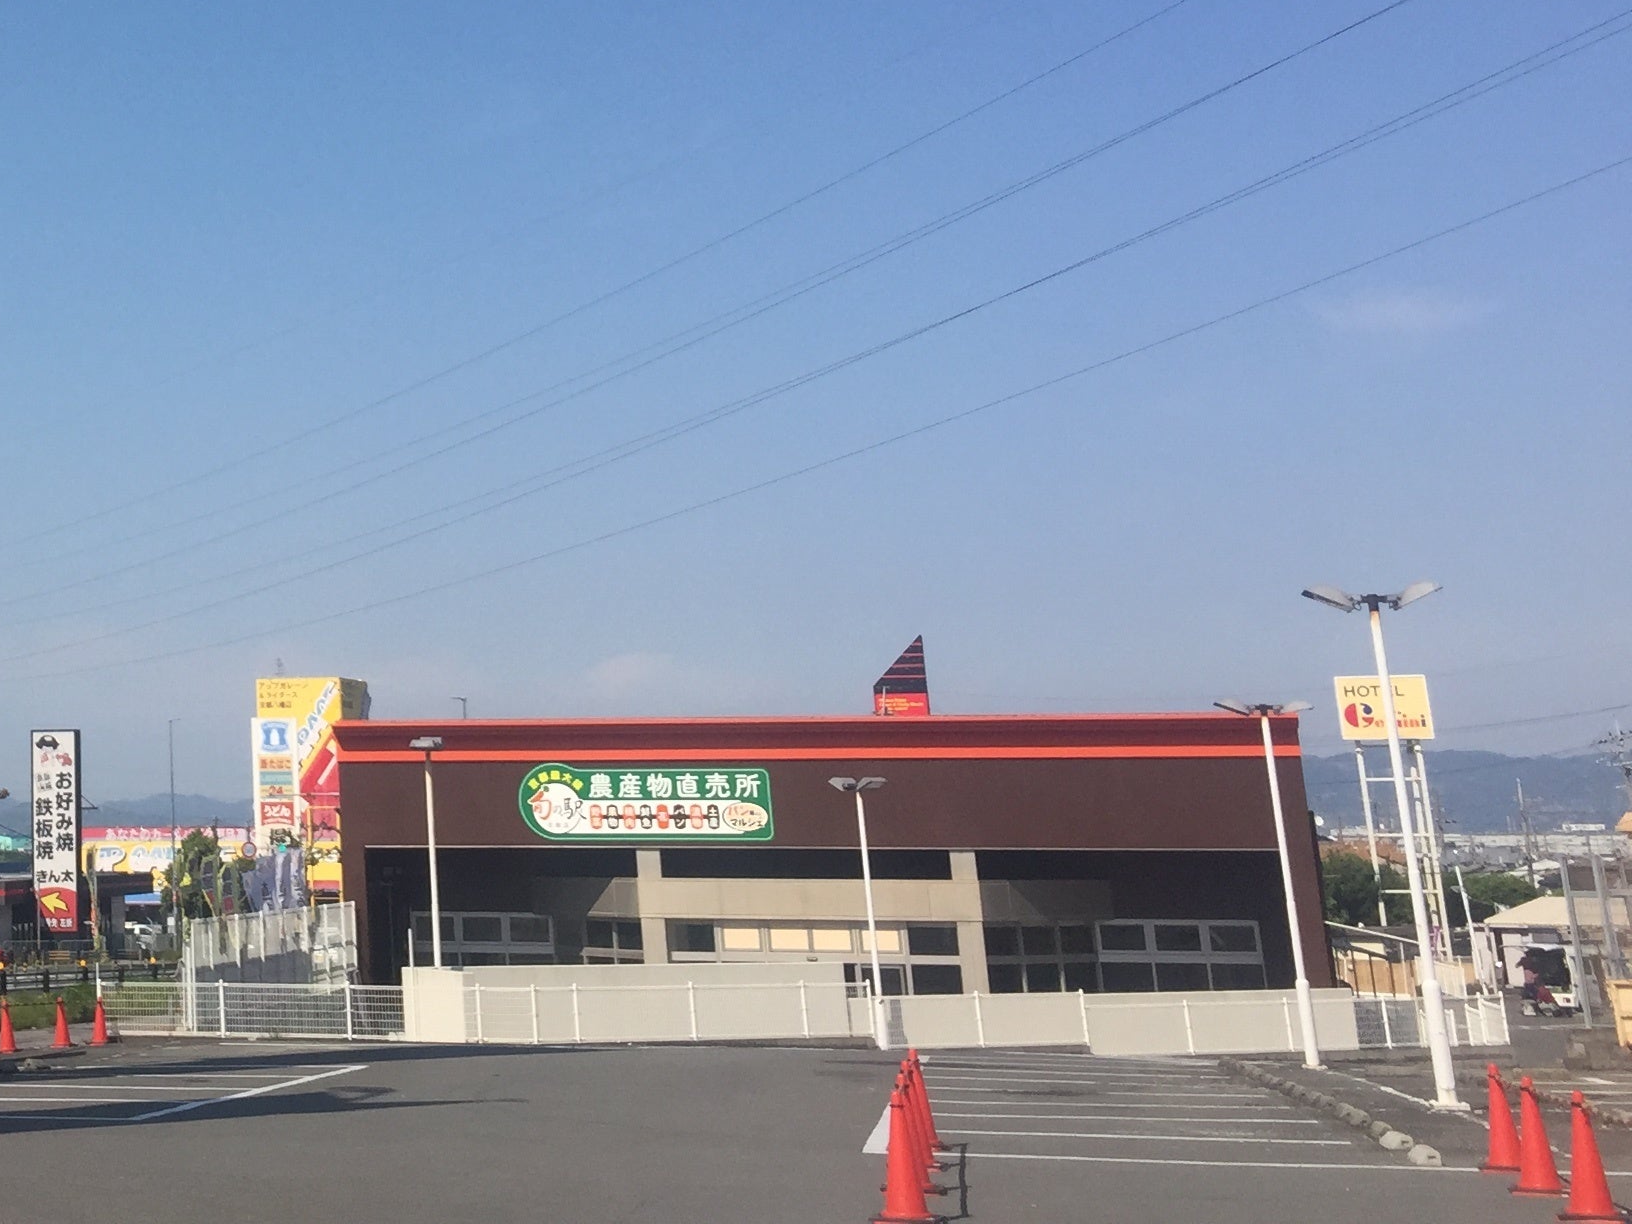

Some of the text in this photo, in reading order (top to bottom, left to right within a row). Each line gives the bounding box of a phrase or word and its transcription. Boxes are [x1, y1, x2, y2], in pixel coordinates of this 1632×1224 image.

[1343, 685, 1405, 697] HOTL
[588, 773, 761, 799] 農産物直売所
[55, 771, 74, 853] お好み焼
[529, 790, 587, 821] 旬の駅
[35, 796, 55, 861] 鉄板焼
[36, 869, 74, 883] きん太
